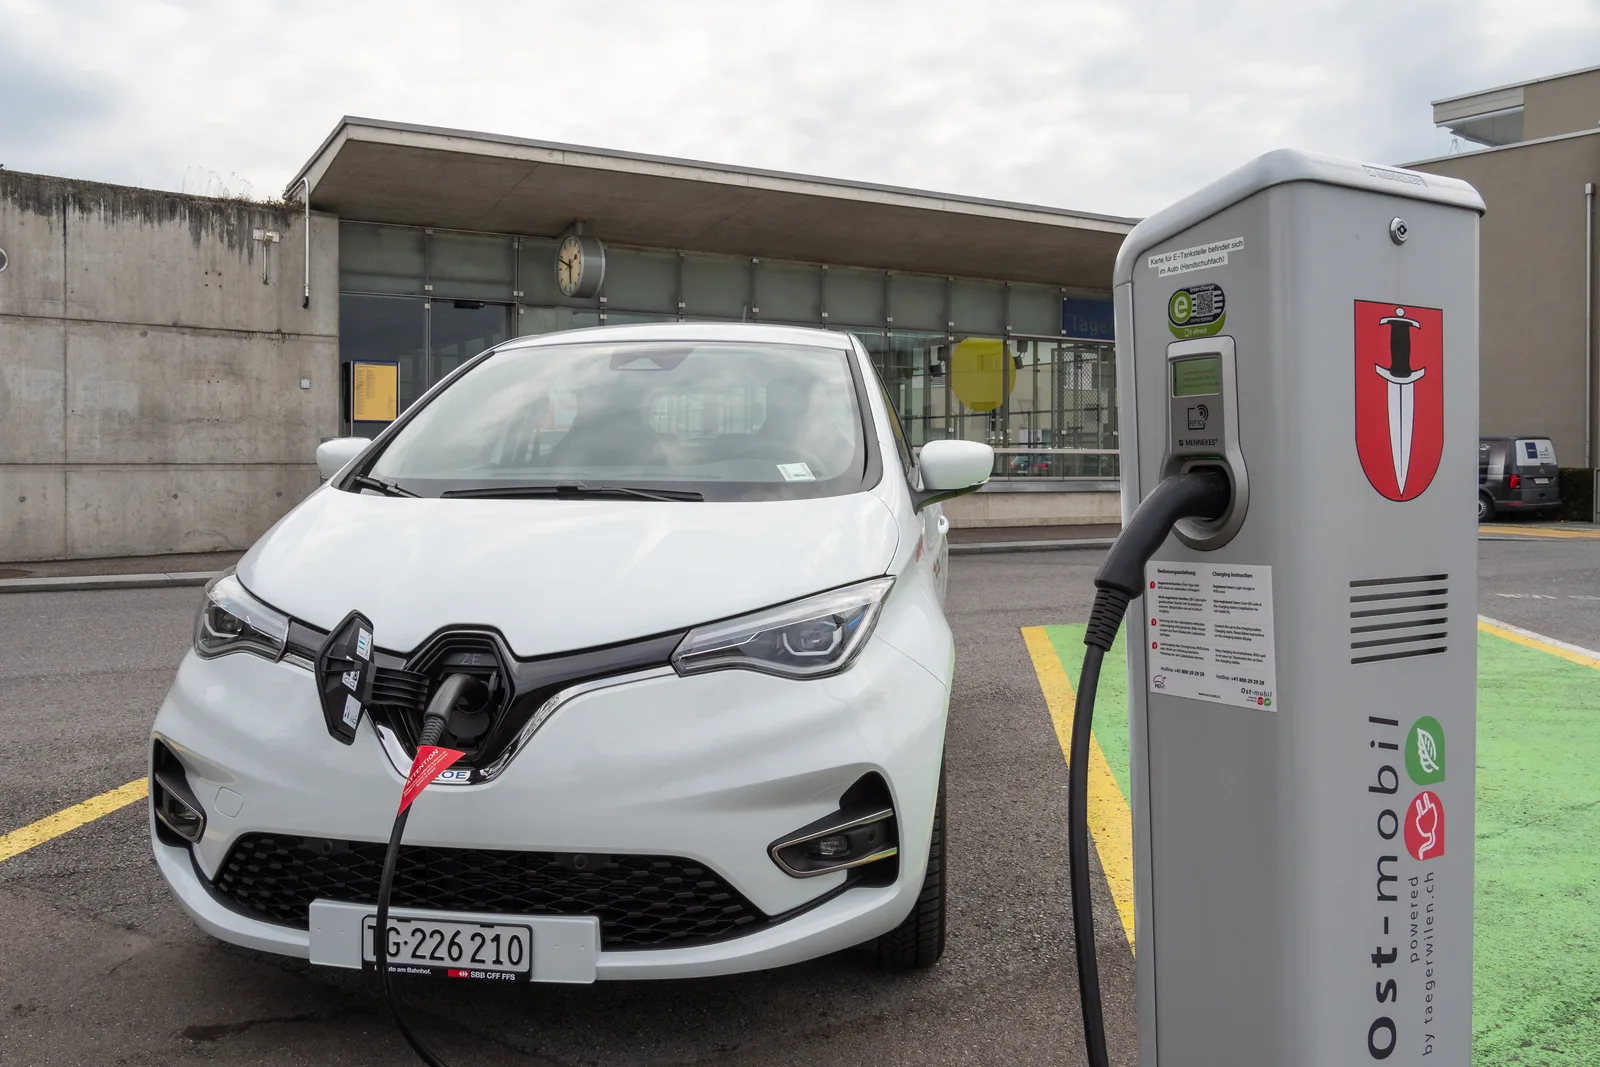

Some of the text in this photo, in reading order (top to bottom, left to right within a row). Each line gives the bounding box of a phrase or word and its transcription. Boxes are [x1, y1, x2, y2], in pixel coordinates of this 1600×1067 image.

[1173, 249, 1207, 260] E-Tankstelle
[1208, 243, 1230, 253] befindet
[1231, 240, 1243, 248] sich
[1180, 256, 1224, 271] (Handschuhfach)
[1241, 688, 1272, 697] Ost-mobil
[406, 748, 439, 785] ATTENTION
[438, 771, 467, 779] OE
[1368, 716, 1399, 1060] Ost-mobil
[1408, 876, 1420, 963] powered
[1422, 872, 1436, 1056] by taegerwilen.ch
